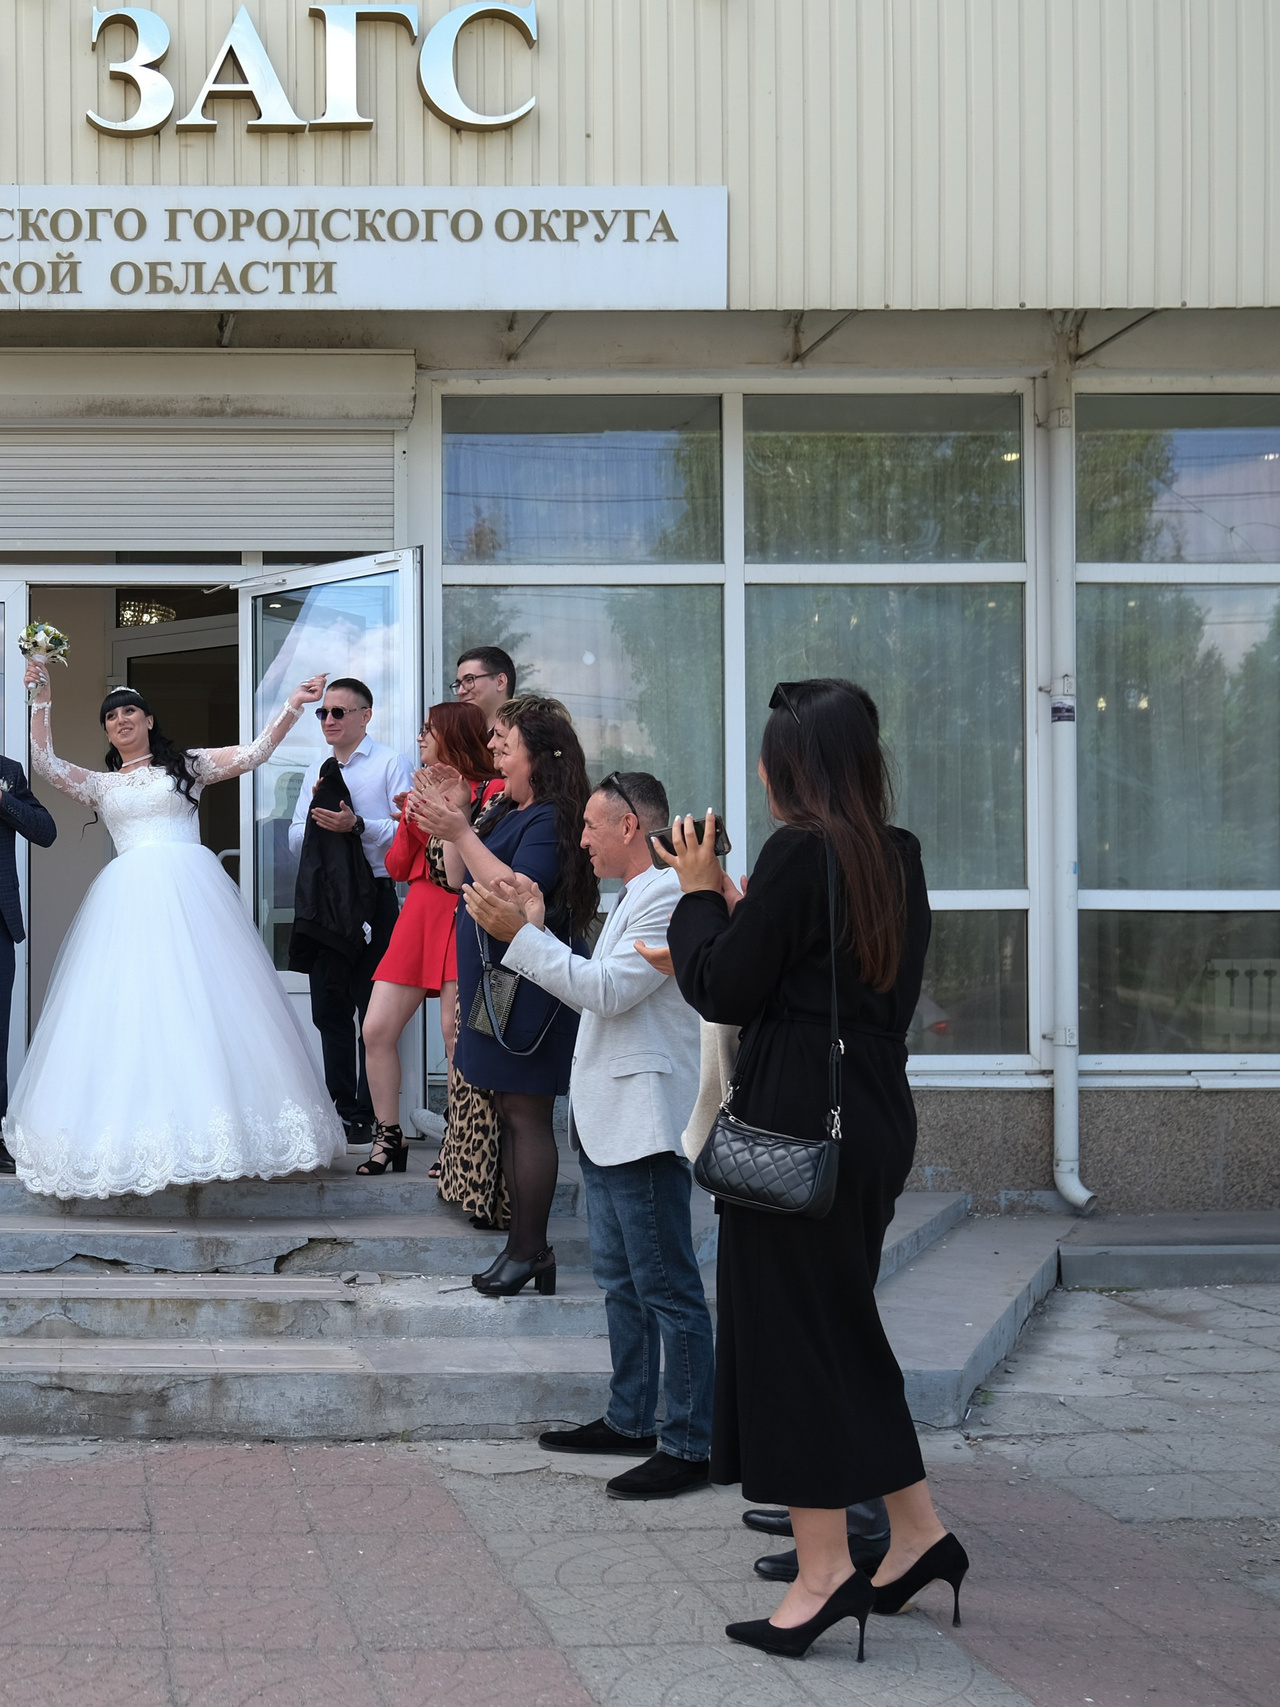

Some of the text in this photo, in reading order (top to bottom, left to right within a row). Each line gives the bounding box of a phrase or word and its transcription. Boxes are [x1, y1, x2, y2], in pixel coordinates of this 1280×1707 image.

[86, 1, 538, 138] ЗАГС
[164, 207, 484, 250] ГОРОДСКОГО
[494, 208, 678, 244] ОКРУГА
[109, 260, 338, 295] ОБЛАСТИ
